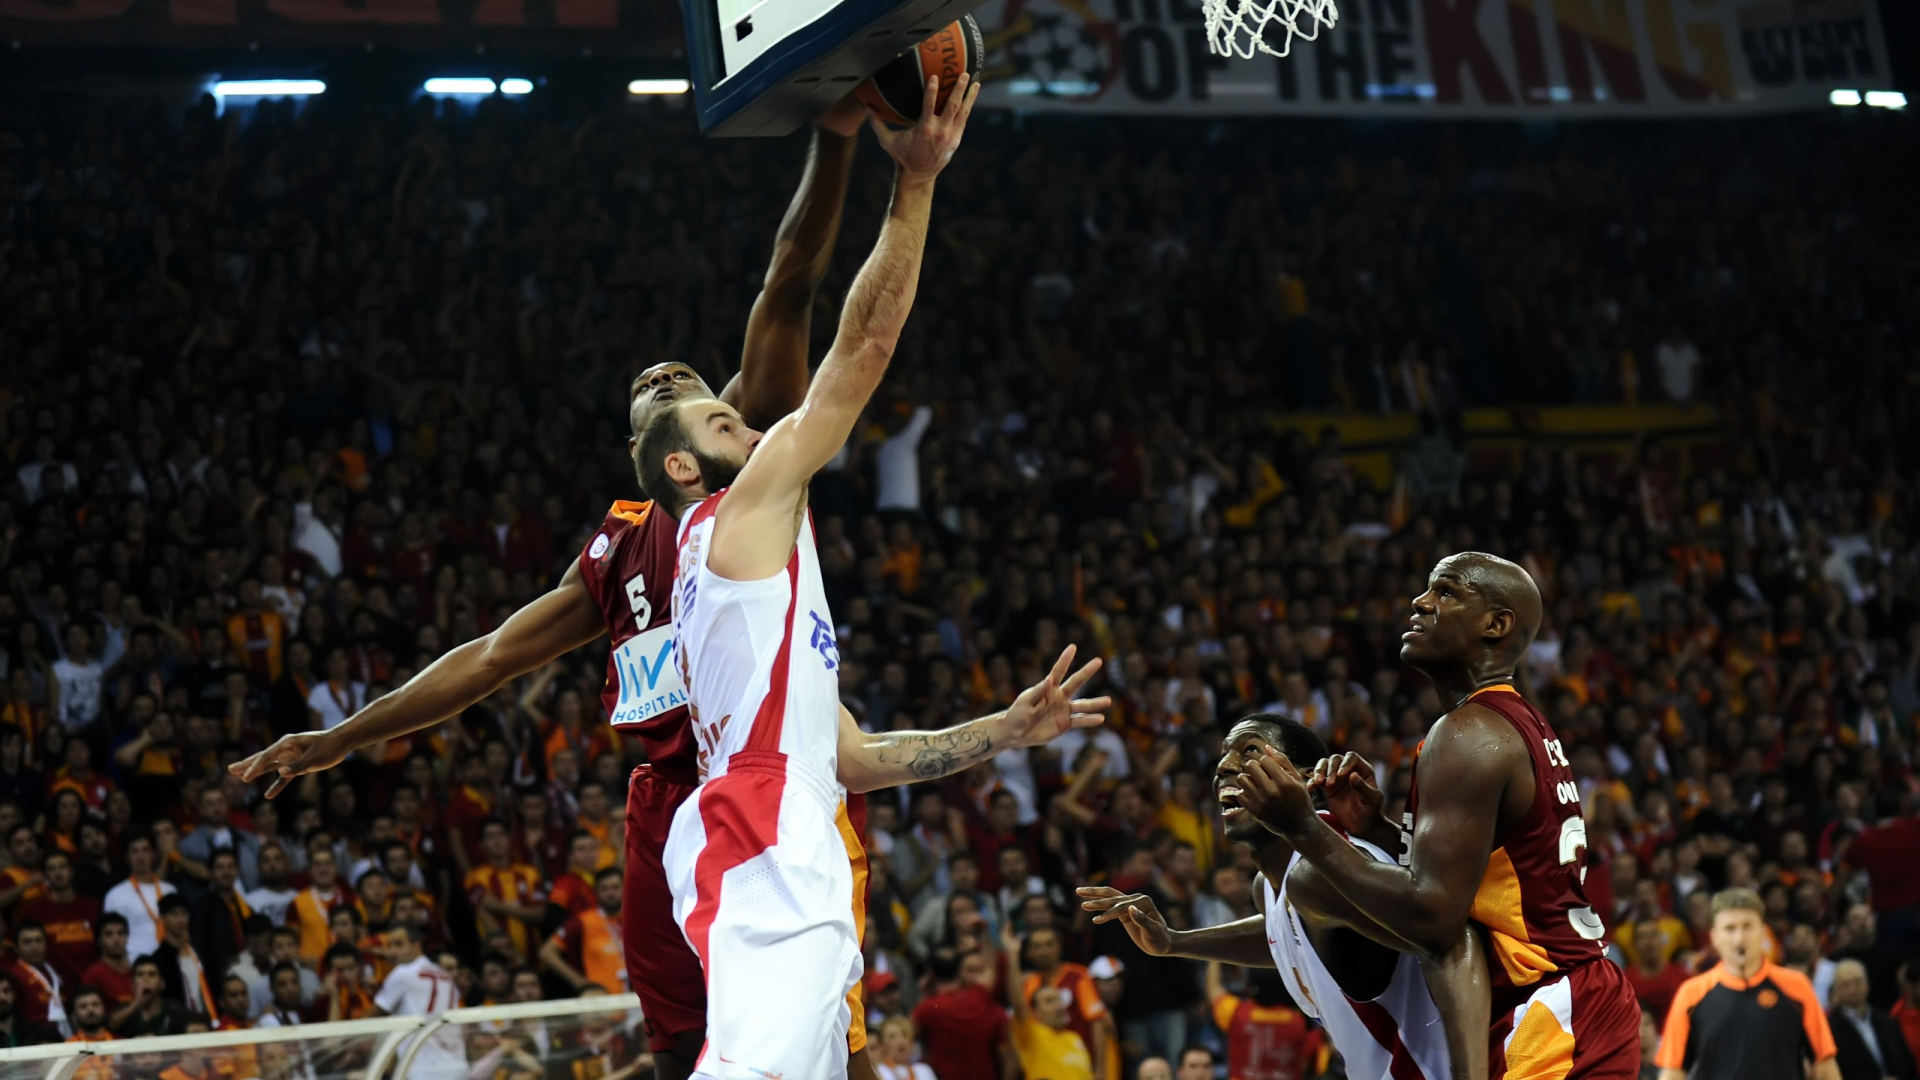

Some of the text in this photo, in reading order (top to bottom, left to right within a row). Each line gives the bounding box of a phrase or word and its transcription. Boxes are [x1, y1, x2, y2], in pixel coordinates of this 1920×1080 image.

[939, 28, 960, 92] SPALD
[1124, 25, 1230, 101] OF
[1257, 25, 1416, 101] THE
[1423, 0, 1737, 104] KING
[625, 573, 652, 631] 5
[616, 639, 672, 704] liv
[613, 688, 687, 723] HOSPITAL
